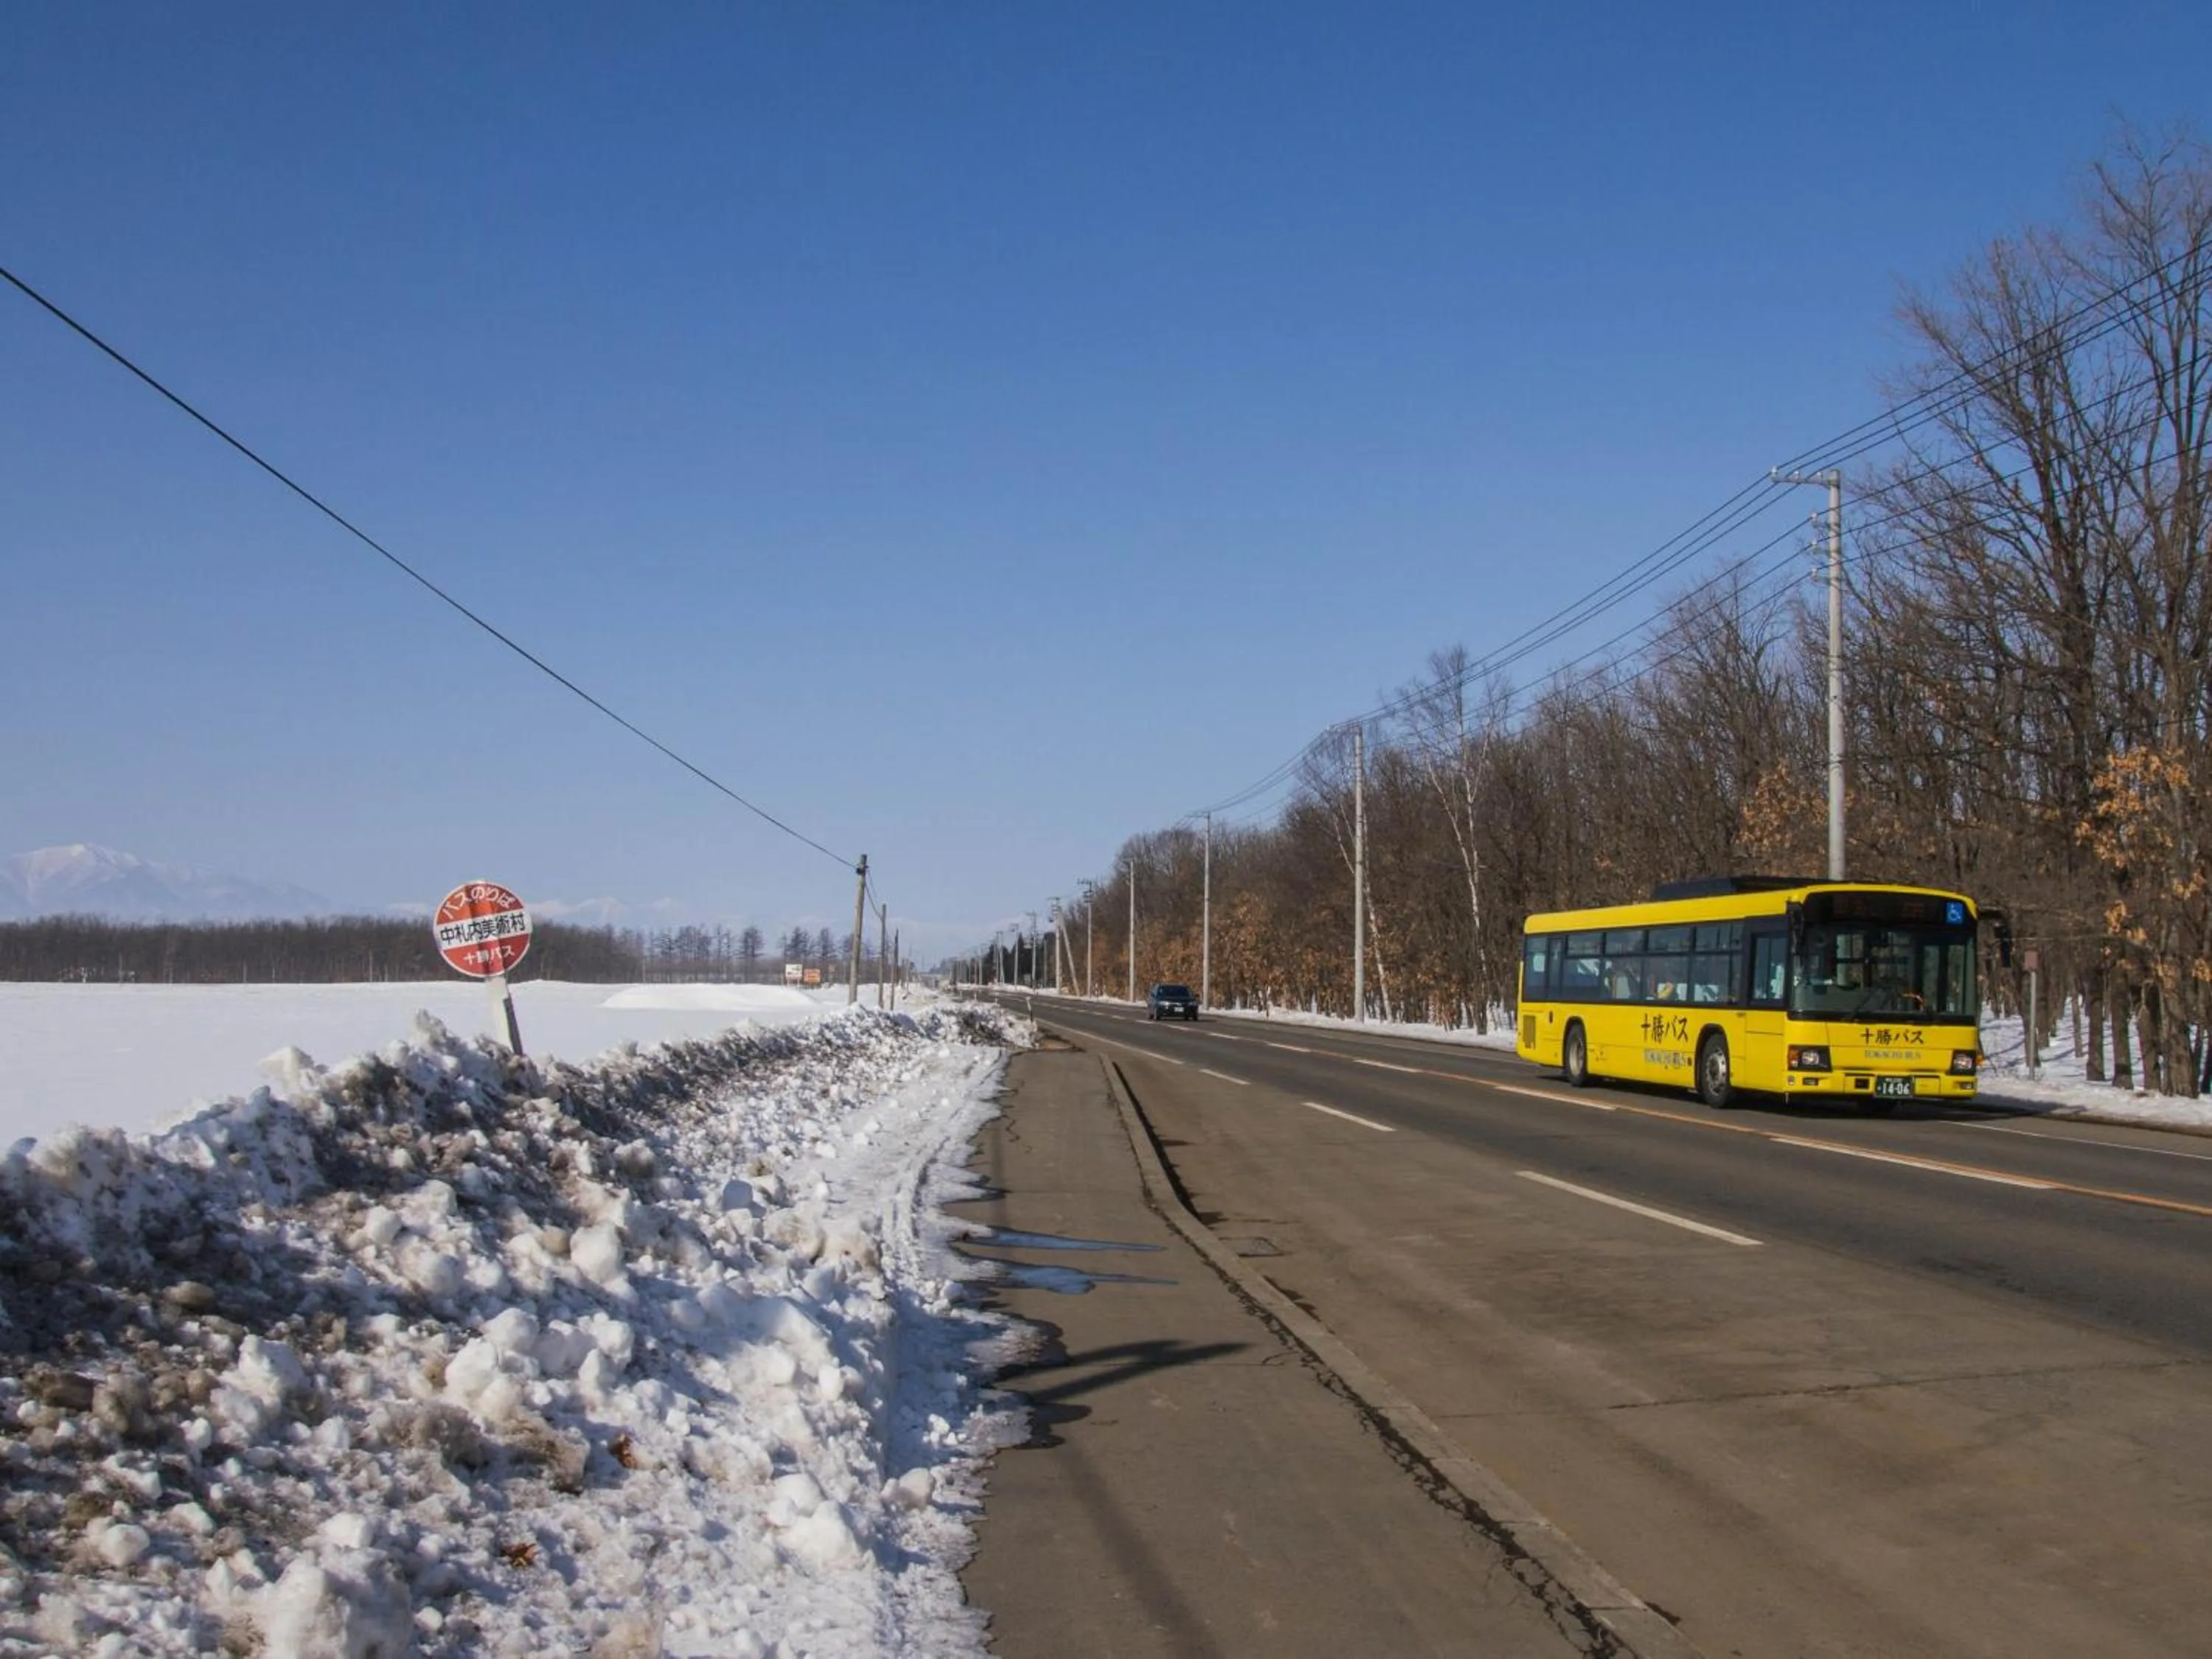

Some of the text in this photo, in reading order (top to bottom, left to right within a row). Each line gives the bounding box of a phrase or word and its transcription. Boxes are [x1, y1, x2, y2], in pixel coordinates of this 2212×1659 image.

[442, 886, 516, 919] バスのりば
[440, 913, 526, 945] 中札内美術村
[1640, 1013, 1688, 1044] 十勝バス
[1860, 1027, 1924, 1045] 十勝バス
